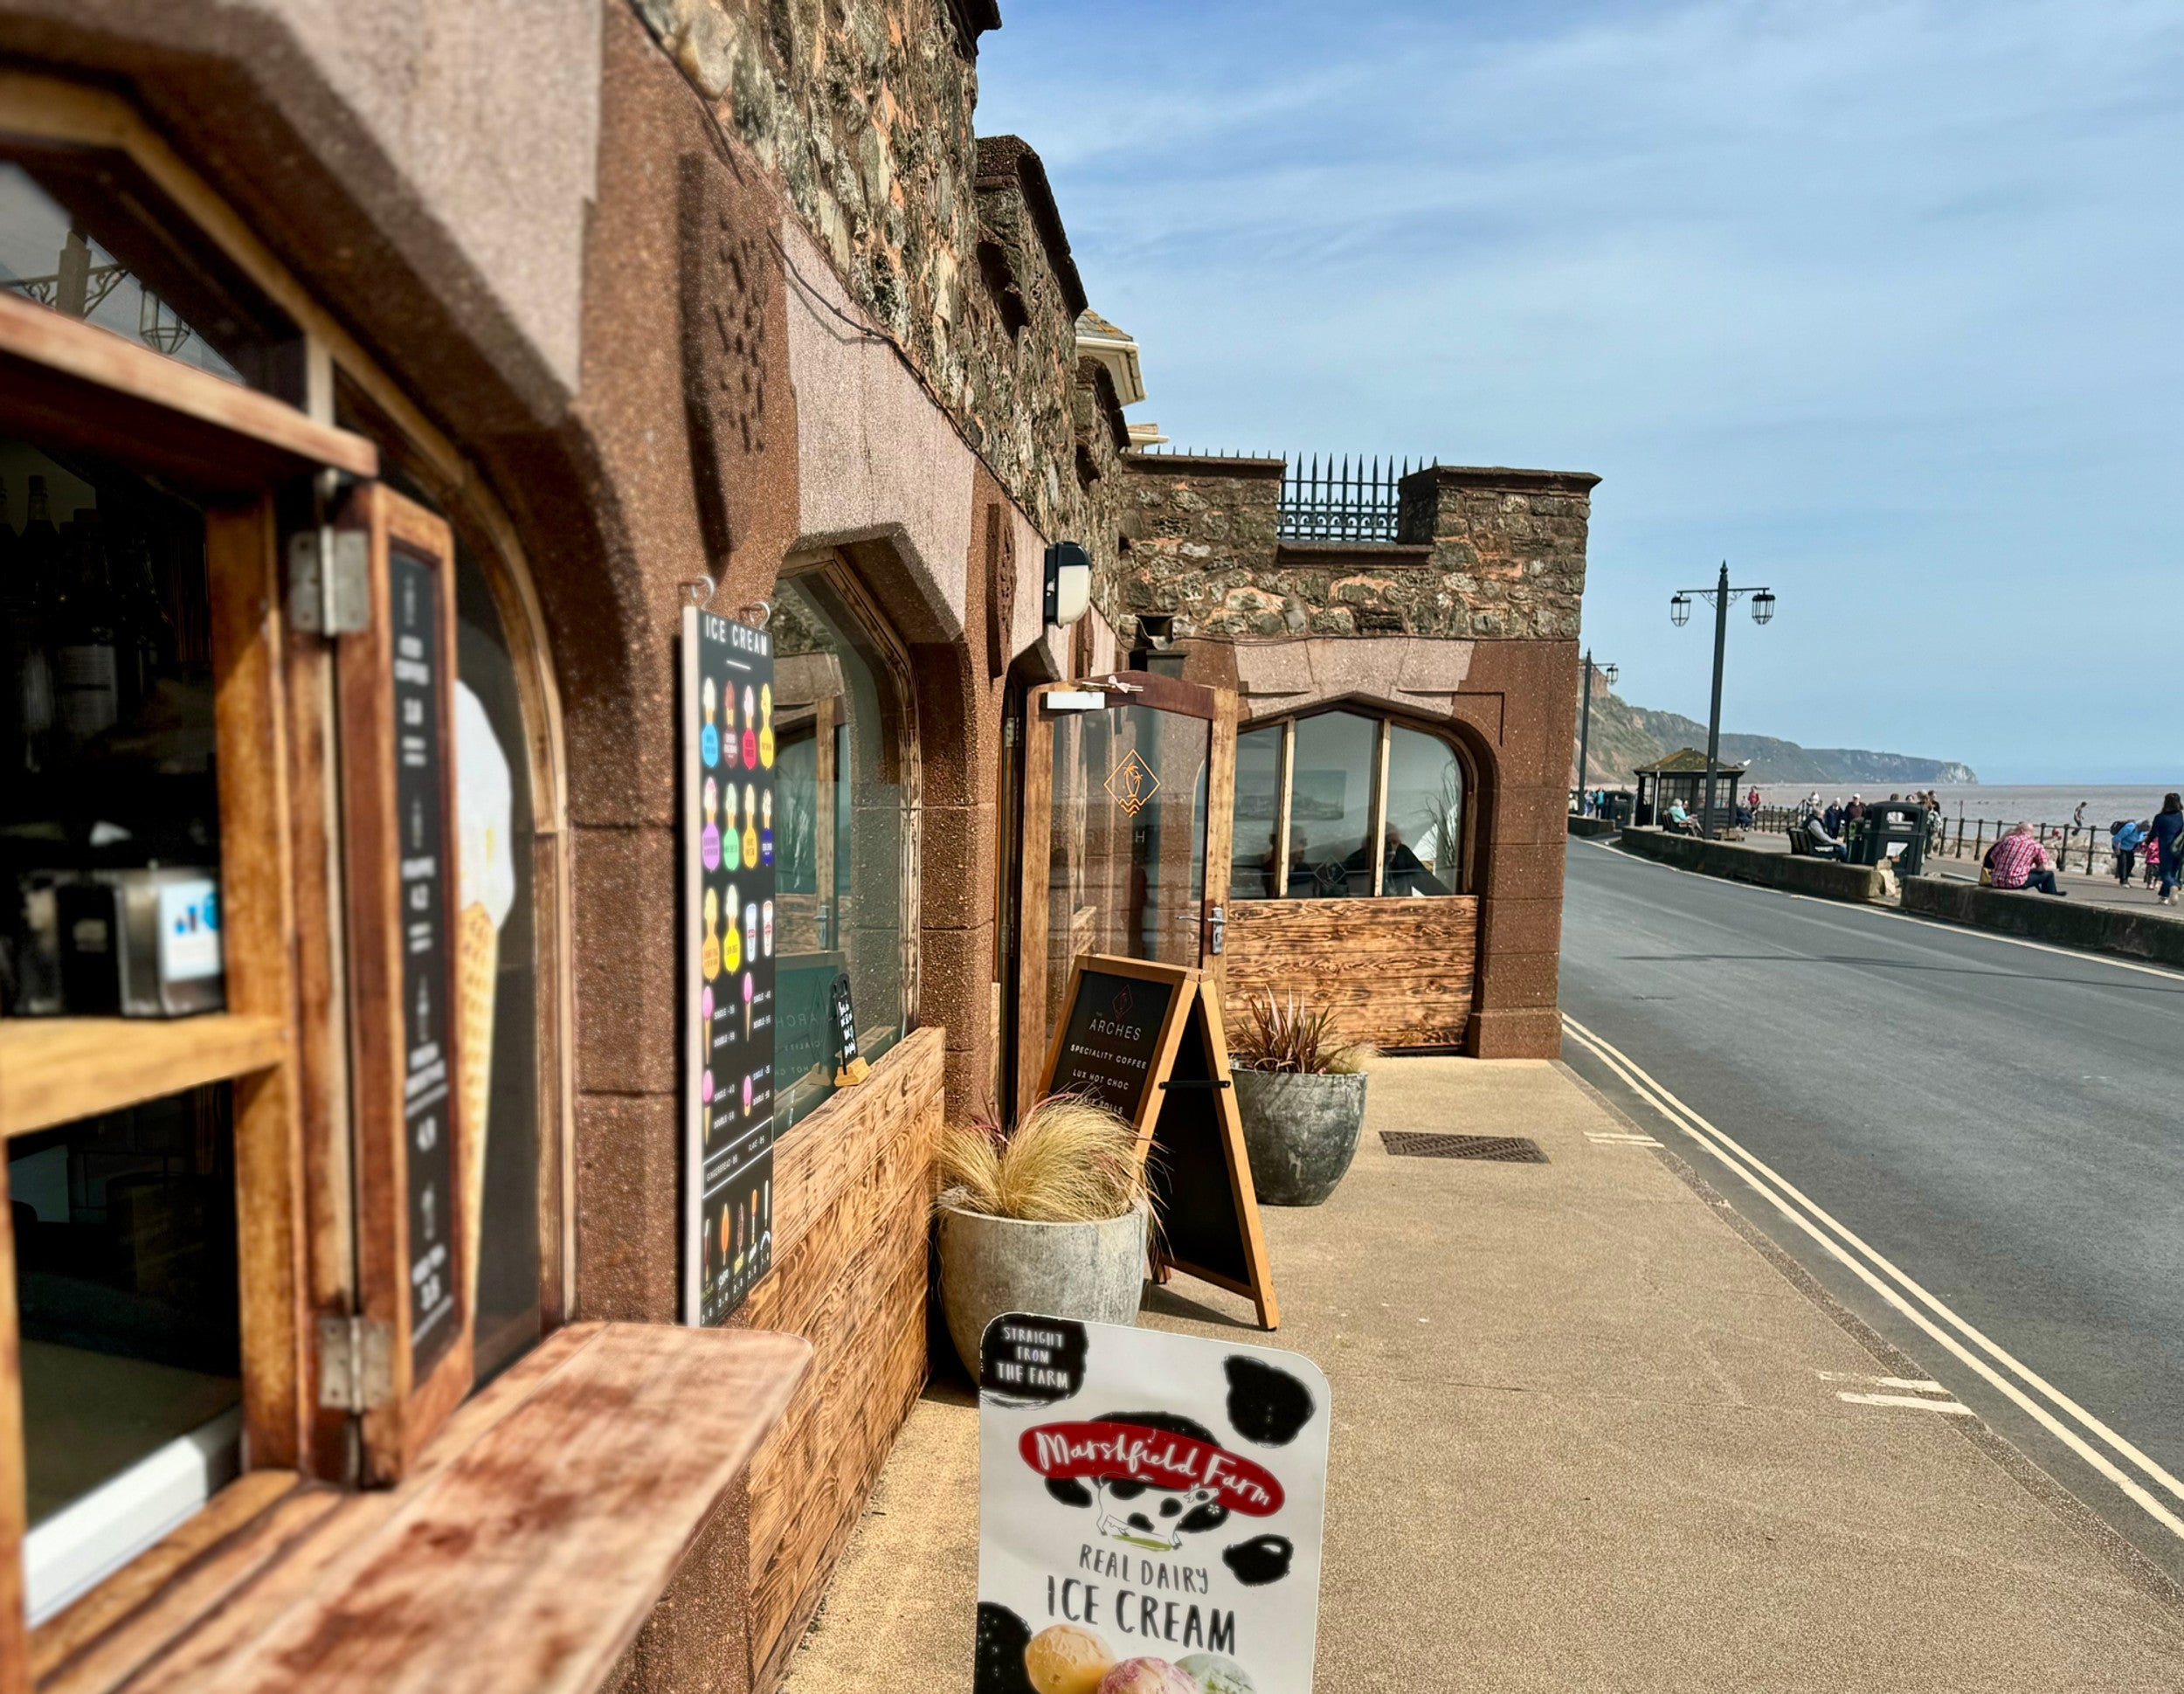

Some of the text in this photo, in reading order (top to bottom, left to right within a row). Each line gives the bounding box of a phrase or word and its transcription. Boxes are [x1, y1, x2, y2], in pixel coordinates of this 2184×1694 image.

[705, 614, 768, 656] ICE CREAM
[1089, 1018, 1142, 1041] ARCHES
[1069, 1043, 1148, 1070] SPECIALITY COFFEE
[1072, 1068, 1130, 1091] LUX HOT CHOC
[1001, 1325, 1066, 1349] STRAIGHT
[1014, 1346, 1050, 1365] FROM
[995, 1362, 1071, 1390] THE FARM
[1034, 1430, 1272, 1509] Marshfield Farm
[1078, 1543, 1209, 1595] REAL DAIRY
[1045, 1573, 1237, 1656] ICE CREAM
